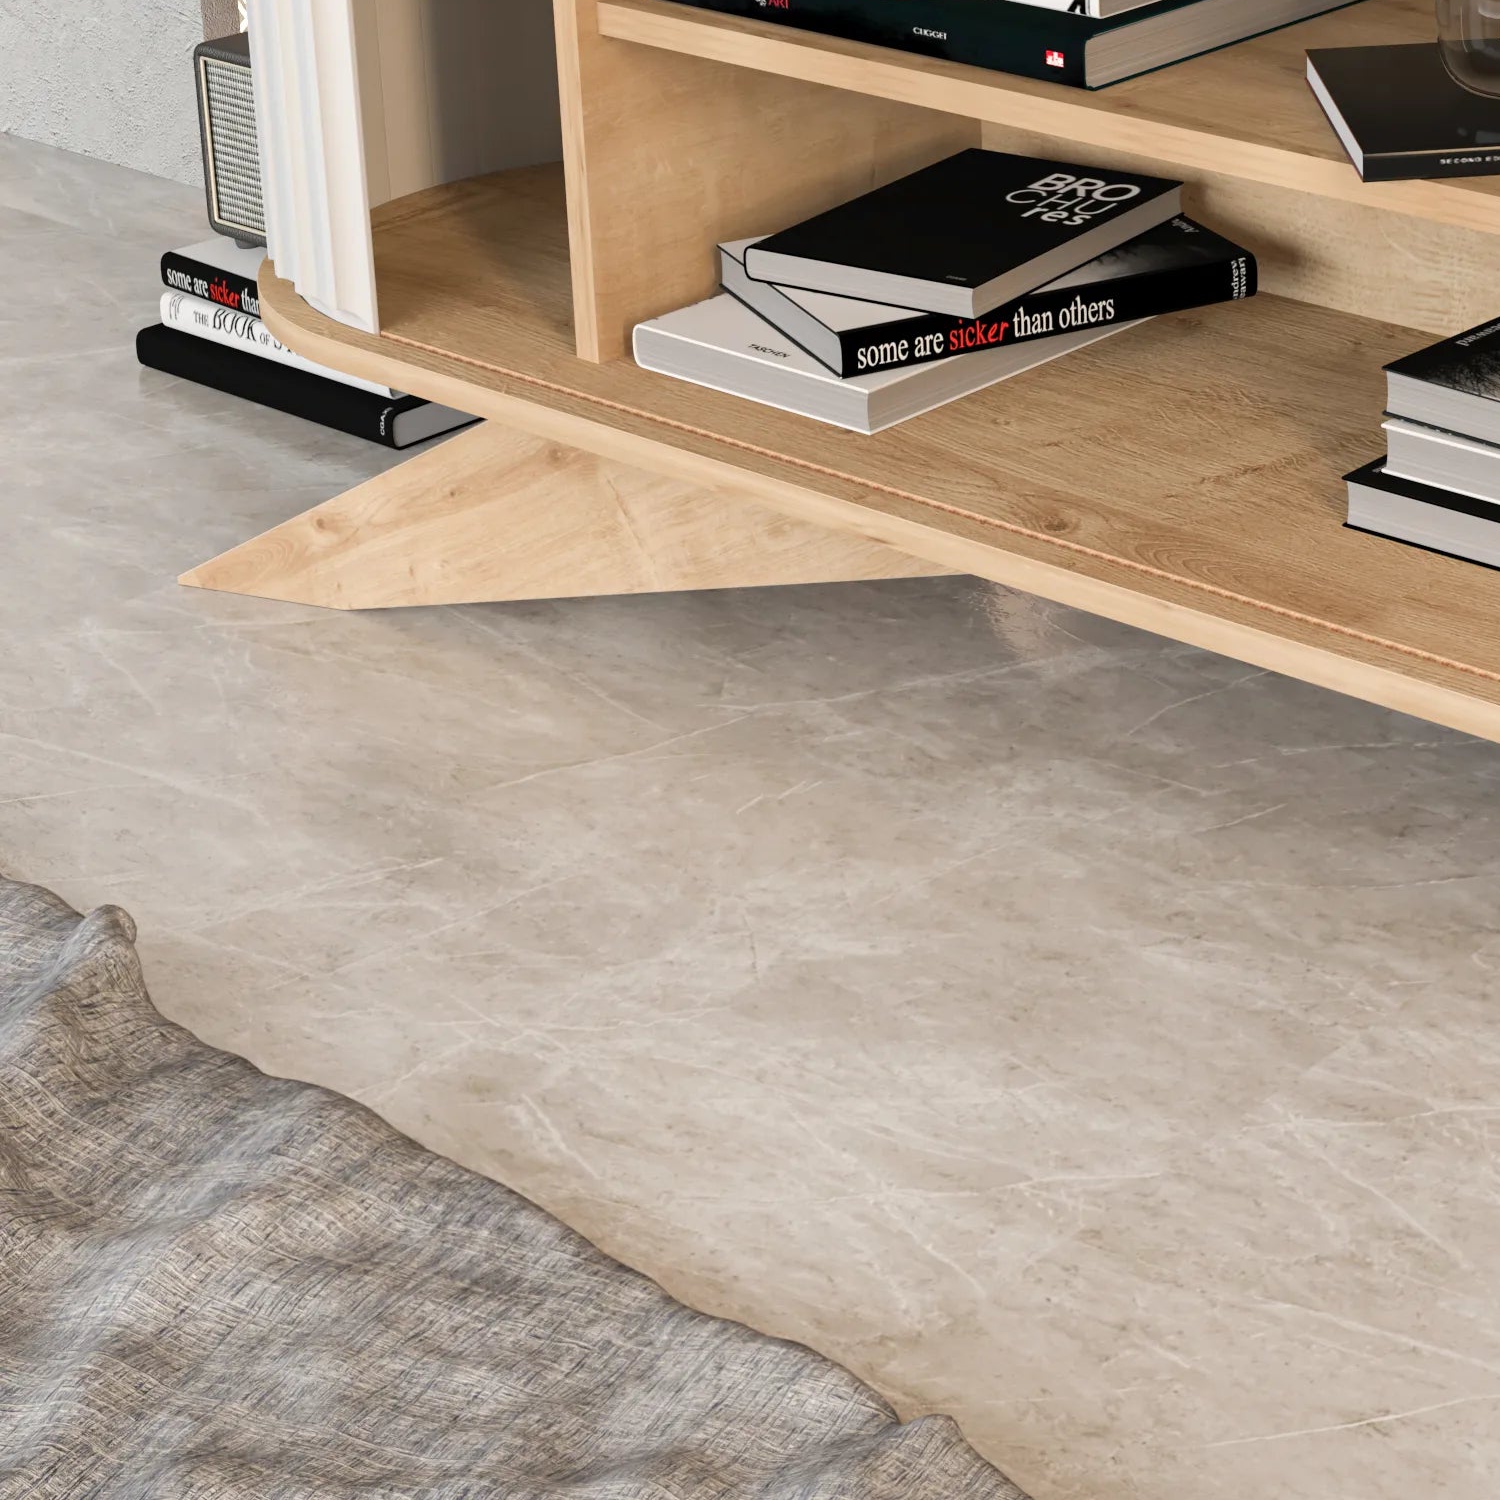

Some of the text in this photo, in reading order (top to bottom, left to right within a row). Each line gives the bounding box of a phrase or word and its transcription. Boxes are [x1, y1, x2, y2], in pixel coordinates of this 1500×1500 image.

[1439, 156, 1482, 165] SECOND
[1005, 189, 1118, 215] CHU
[1027, 173, 1141, 202] BRO
[1020, 206, 1093, 226] res
[166, 267, 192, 290] some
[193, 280, 209, 298] are
[210, 276, 240, 308] sicker
[1230, 260, 1239, 299] ndrew
[193, 308, 271, 346] THE BOOK OF
[857, 297, 1115, 369] some are sicker than others
[747, 343, 791, 359] TASCHEN
